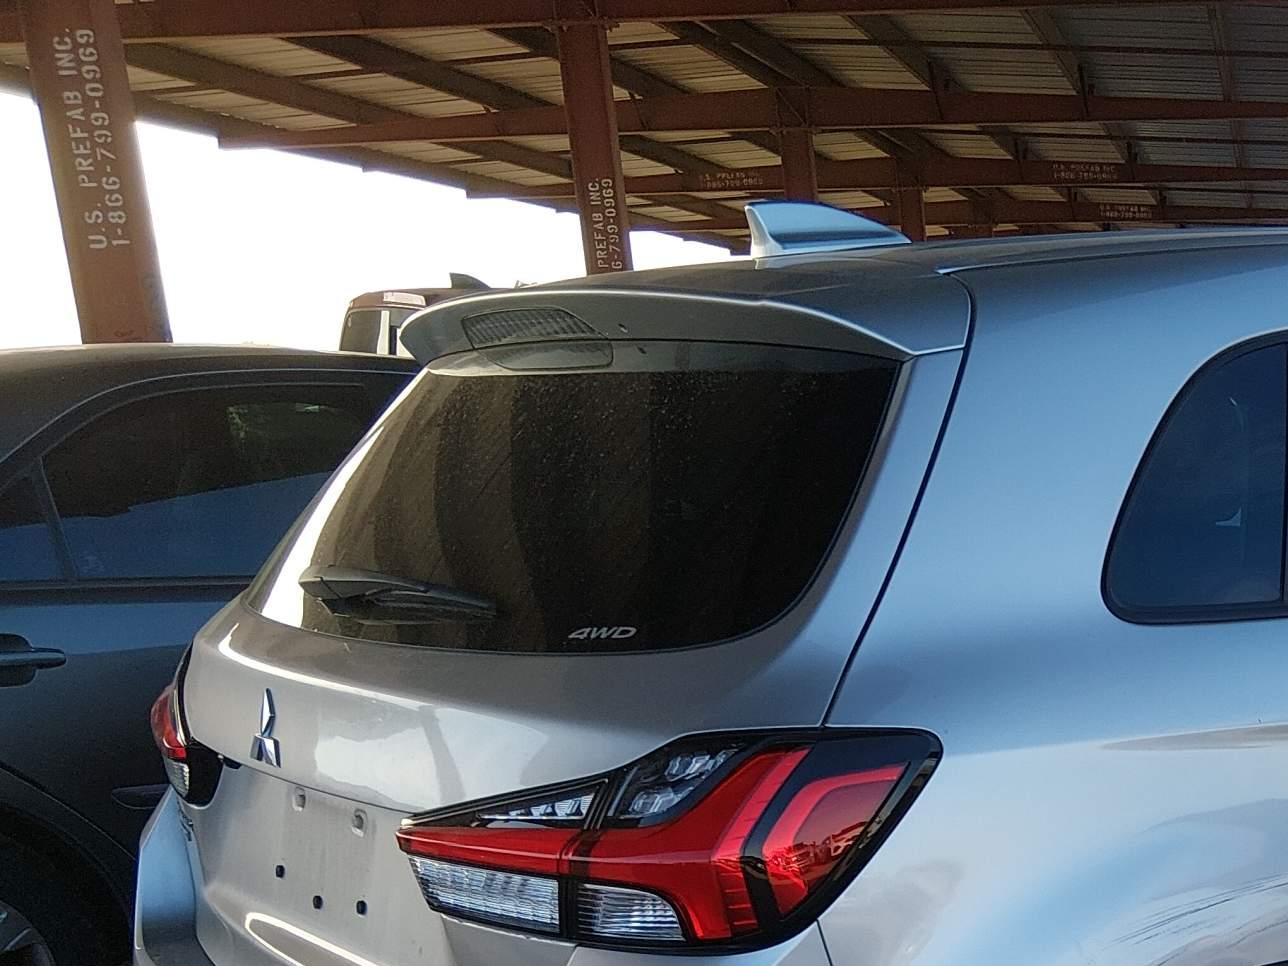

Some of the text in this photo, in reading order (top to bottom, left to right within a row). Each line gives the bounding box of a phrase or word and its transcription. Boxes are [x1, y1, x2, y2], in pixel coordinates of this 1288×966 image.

[53, 28, 107, 249] U.S. PREFAB INC.
[588, 178, 609, 268] PREFAB INC.
[567, 626, 637, 640] 4WD
